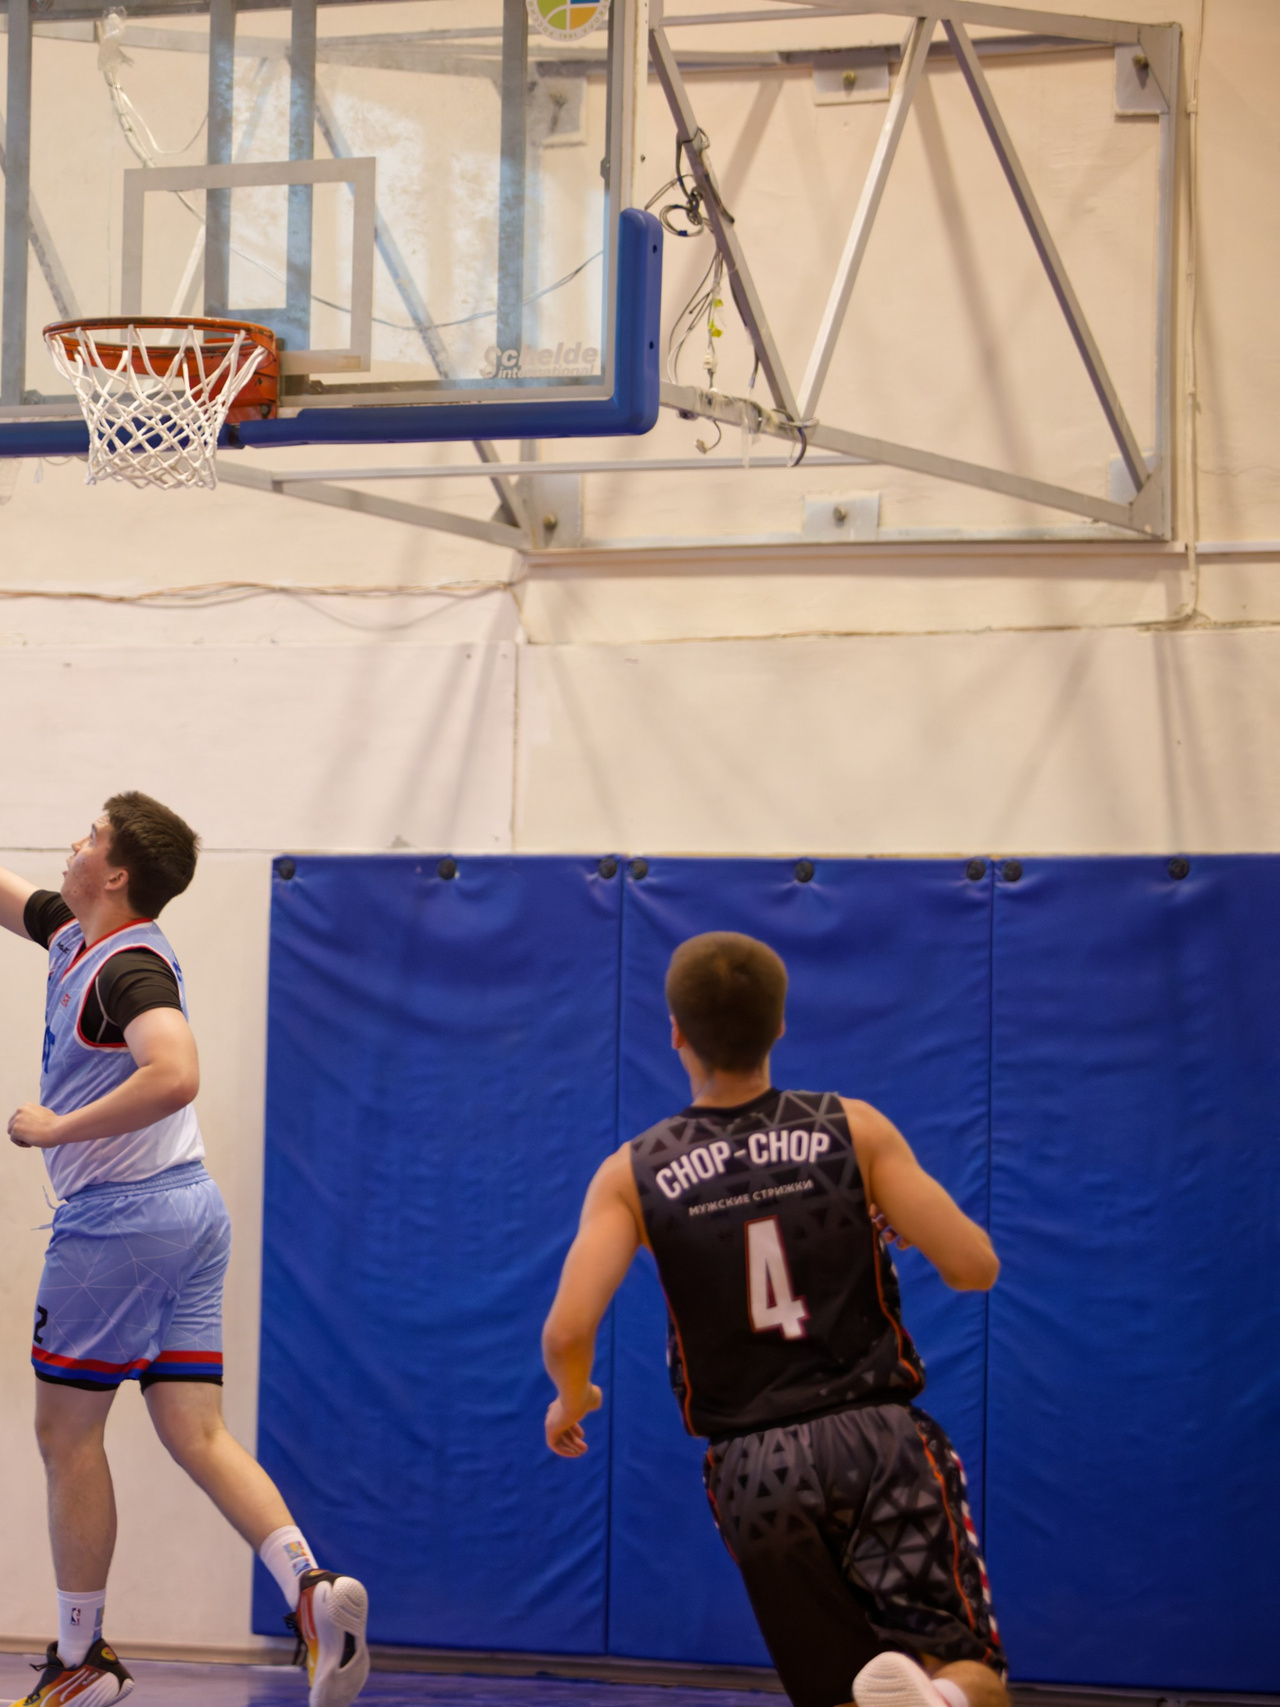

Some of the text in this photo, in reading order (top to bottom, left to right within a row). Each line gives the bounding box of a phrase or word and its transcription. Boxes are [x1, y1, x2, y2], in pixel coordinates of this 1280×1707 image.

[479, 342, 599, 379] Schelde
[655, 1129, 831, 1200] CHOP-CHOP
[688, 1178, 815, 1217] МУЖСКИЕ СТРИЖКИ
[744, 1214, 810, 1341] 4
